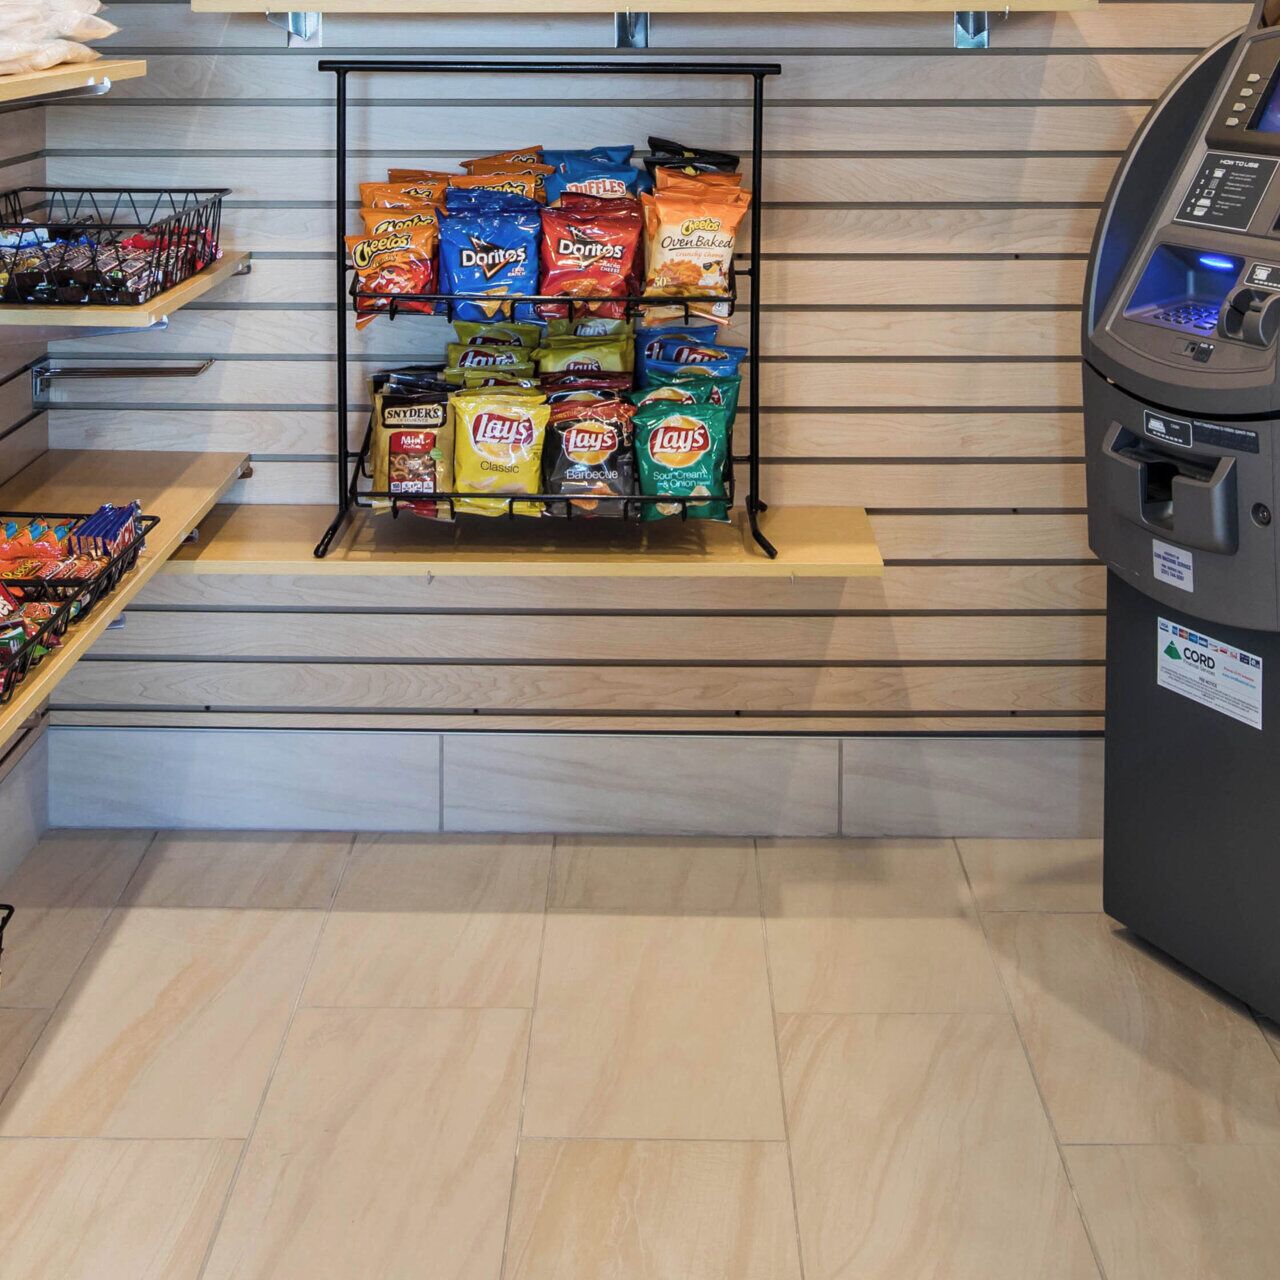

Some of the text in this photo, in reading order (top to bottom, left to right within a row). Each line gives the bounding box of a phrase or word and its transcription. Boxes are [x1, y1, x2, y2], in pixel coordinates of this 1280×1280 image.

[566, 179, 627, 197] RUFFLES
[681, 218, 721, 236] Cheetos
[558, 239, 624, 259] Doritos
[661, 235, 734, 249] Oven Baked
[352, 234, 411, 269] Cheetos
[462, 246, 527, 267] Doritos
[386, 407, 441, 419] SNYDER'S
[476, 413, 532, 444] Lay's
[569, 427, 616, 453] Lay's
[653, 426, 707, 453] Lay's
[480, 460, 520, 474] Classic
[566, 469, 619, 480] Barbecue
[653, 470, 705, 481] Sour Cream
[663, 478, 696, 488] & Onion
[1183, 647, 1216, 670] CORD
